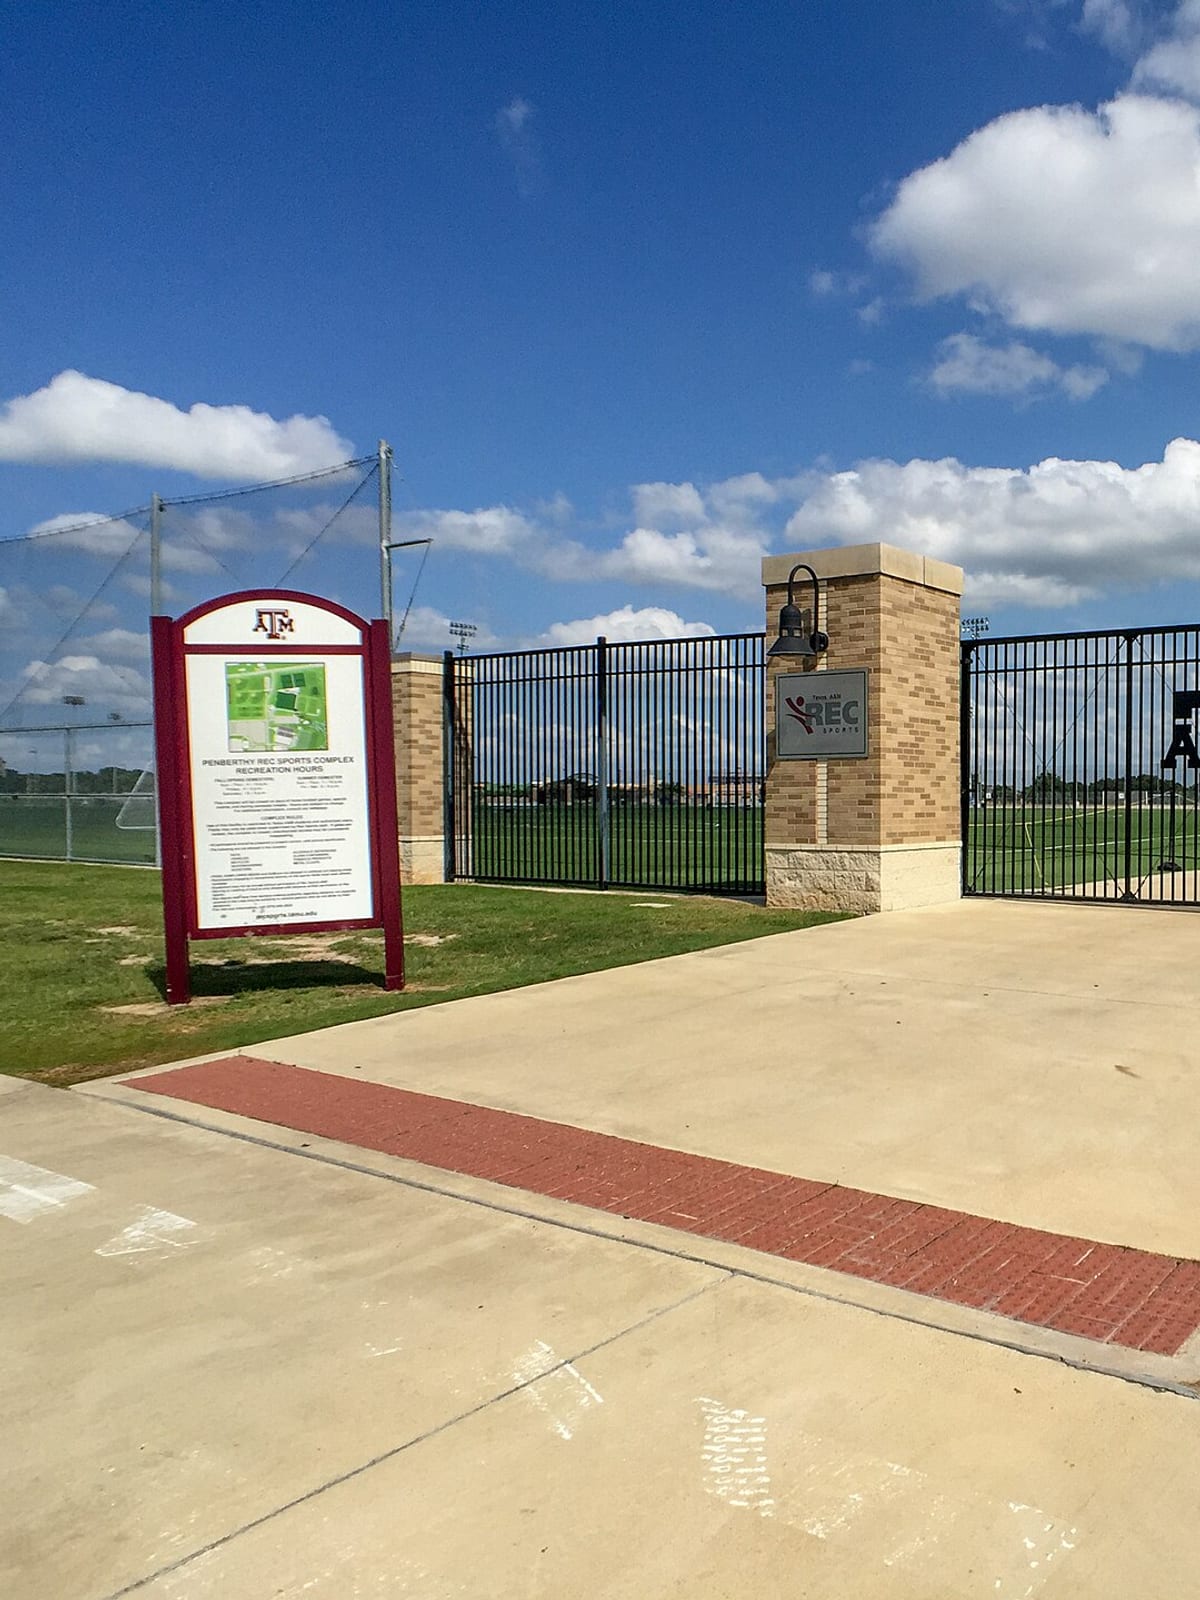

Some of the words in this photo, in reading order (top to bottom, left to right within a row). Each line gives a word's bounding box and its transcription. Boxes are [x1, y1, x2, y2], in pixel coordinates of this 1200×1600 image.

[805, 701, 859, 726] REC
[202, 759, 255, 767] PENBERTHY
[257, 758, 276, 766] REC
[277, 757, 312, 765] SPORTS
[313, 756, 354, 764] COMPLEX
[236, 766, 291, 774] RECREATION
[293, 765, 323, 773] HOURS
